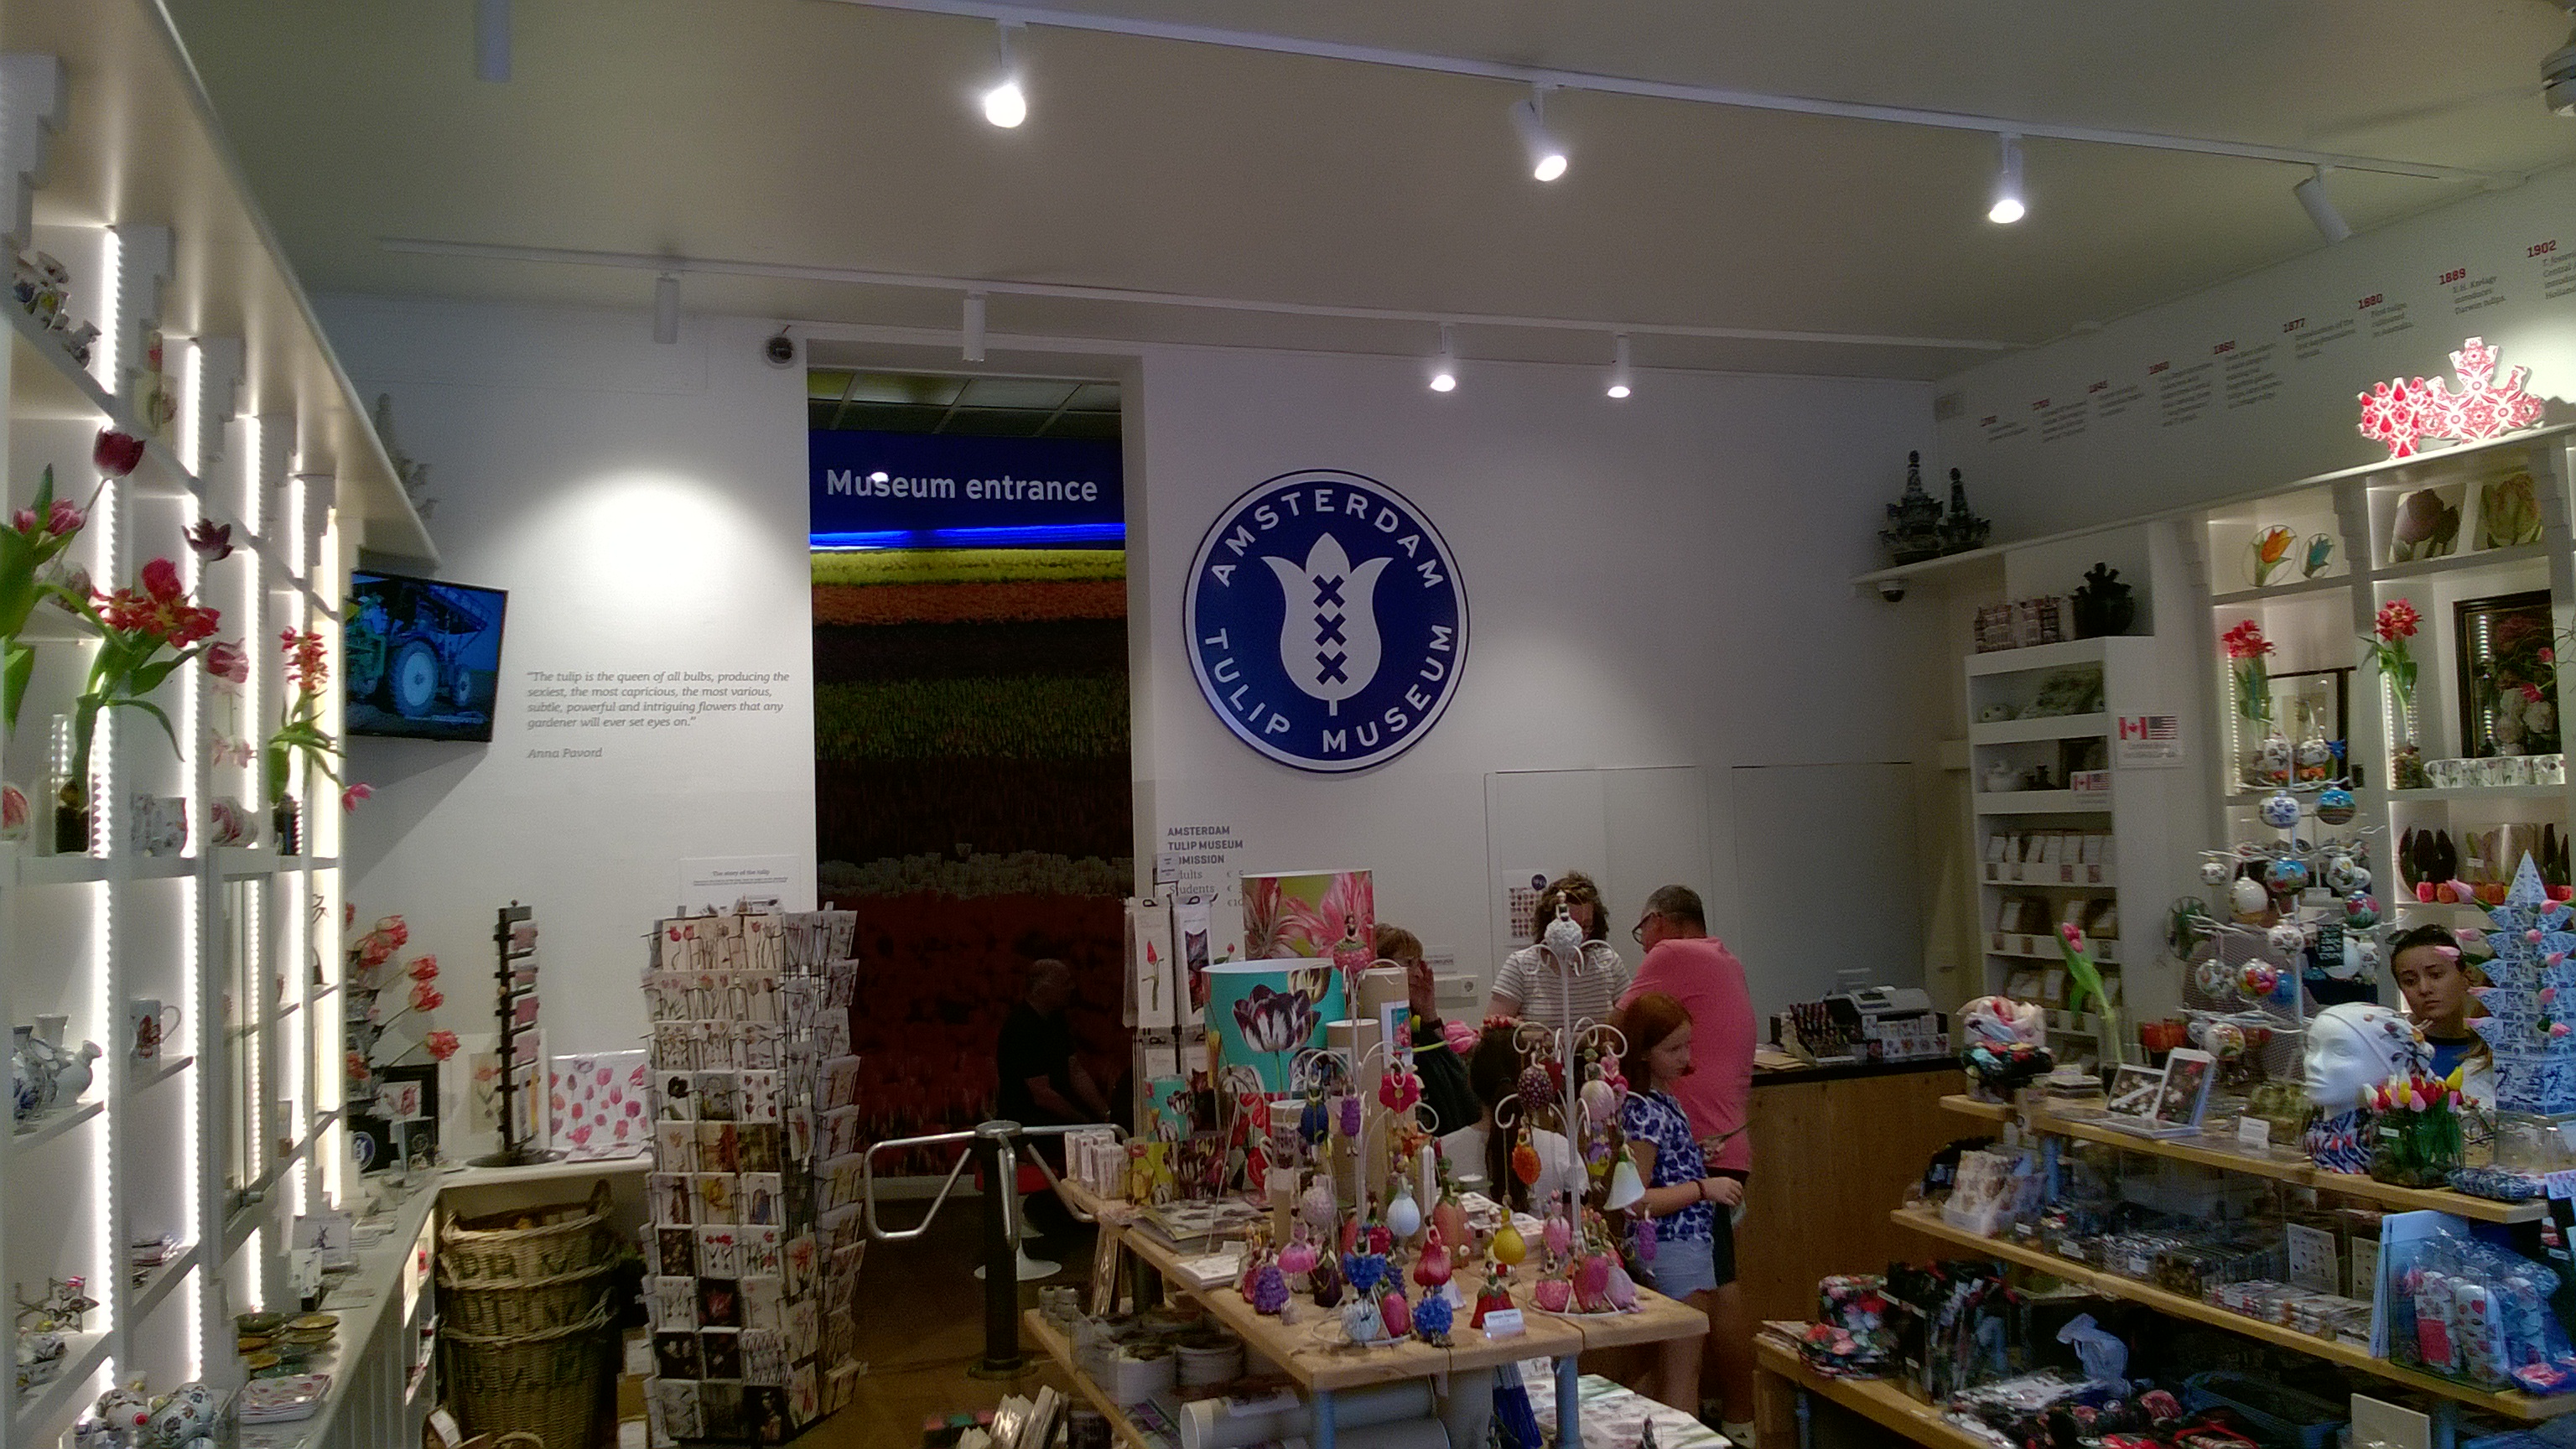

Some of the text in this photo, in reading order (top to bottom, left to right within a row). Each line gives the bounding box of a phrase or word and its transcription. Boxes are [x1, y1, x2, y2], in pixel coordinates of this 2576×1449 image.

[2527, 240, 2557, 257] 1902
[2438, 267, 2466, 285] 1889
[827, 469, 1098, 502] Museum entrance
[1212, 489, 1445, 589] AMSTERDAM
[557, 672, 582, 683] tulip
[585, 673, 595, 682] is
[597, 672, 615, 682] the
[617, 673, 650, 683] queen
[653, 671, 665, 683] of
[667, 671, 681, 681] all
[683, 672, 714, 683] bulbs,
[718, 673, 770, 684] producing
[773, 672, 790, 682] the
[527, 687, 772, 698] sexiest, the most capricious, the most various,
[1205, 625, 1452, 754] TULIP MUSEUM
[527, 701, 784, 714] subtle, powerful and intriguing flowers that any
[527, 719, 577, 730] gardener
[580, 718, 600, 727] will
[603, 719, 626, 727] ever
[629, 718, 645, 727] set
[647, 719, 671, 729] eyes
[527, 748, 603, 759] Anna Pavord
[1168, 826, 1230, 836] AMSTERDAM
[1168, 840, 1243, 850] TULIP MUSEUM
[1179, 854, 1224, 865] MISSION
